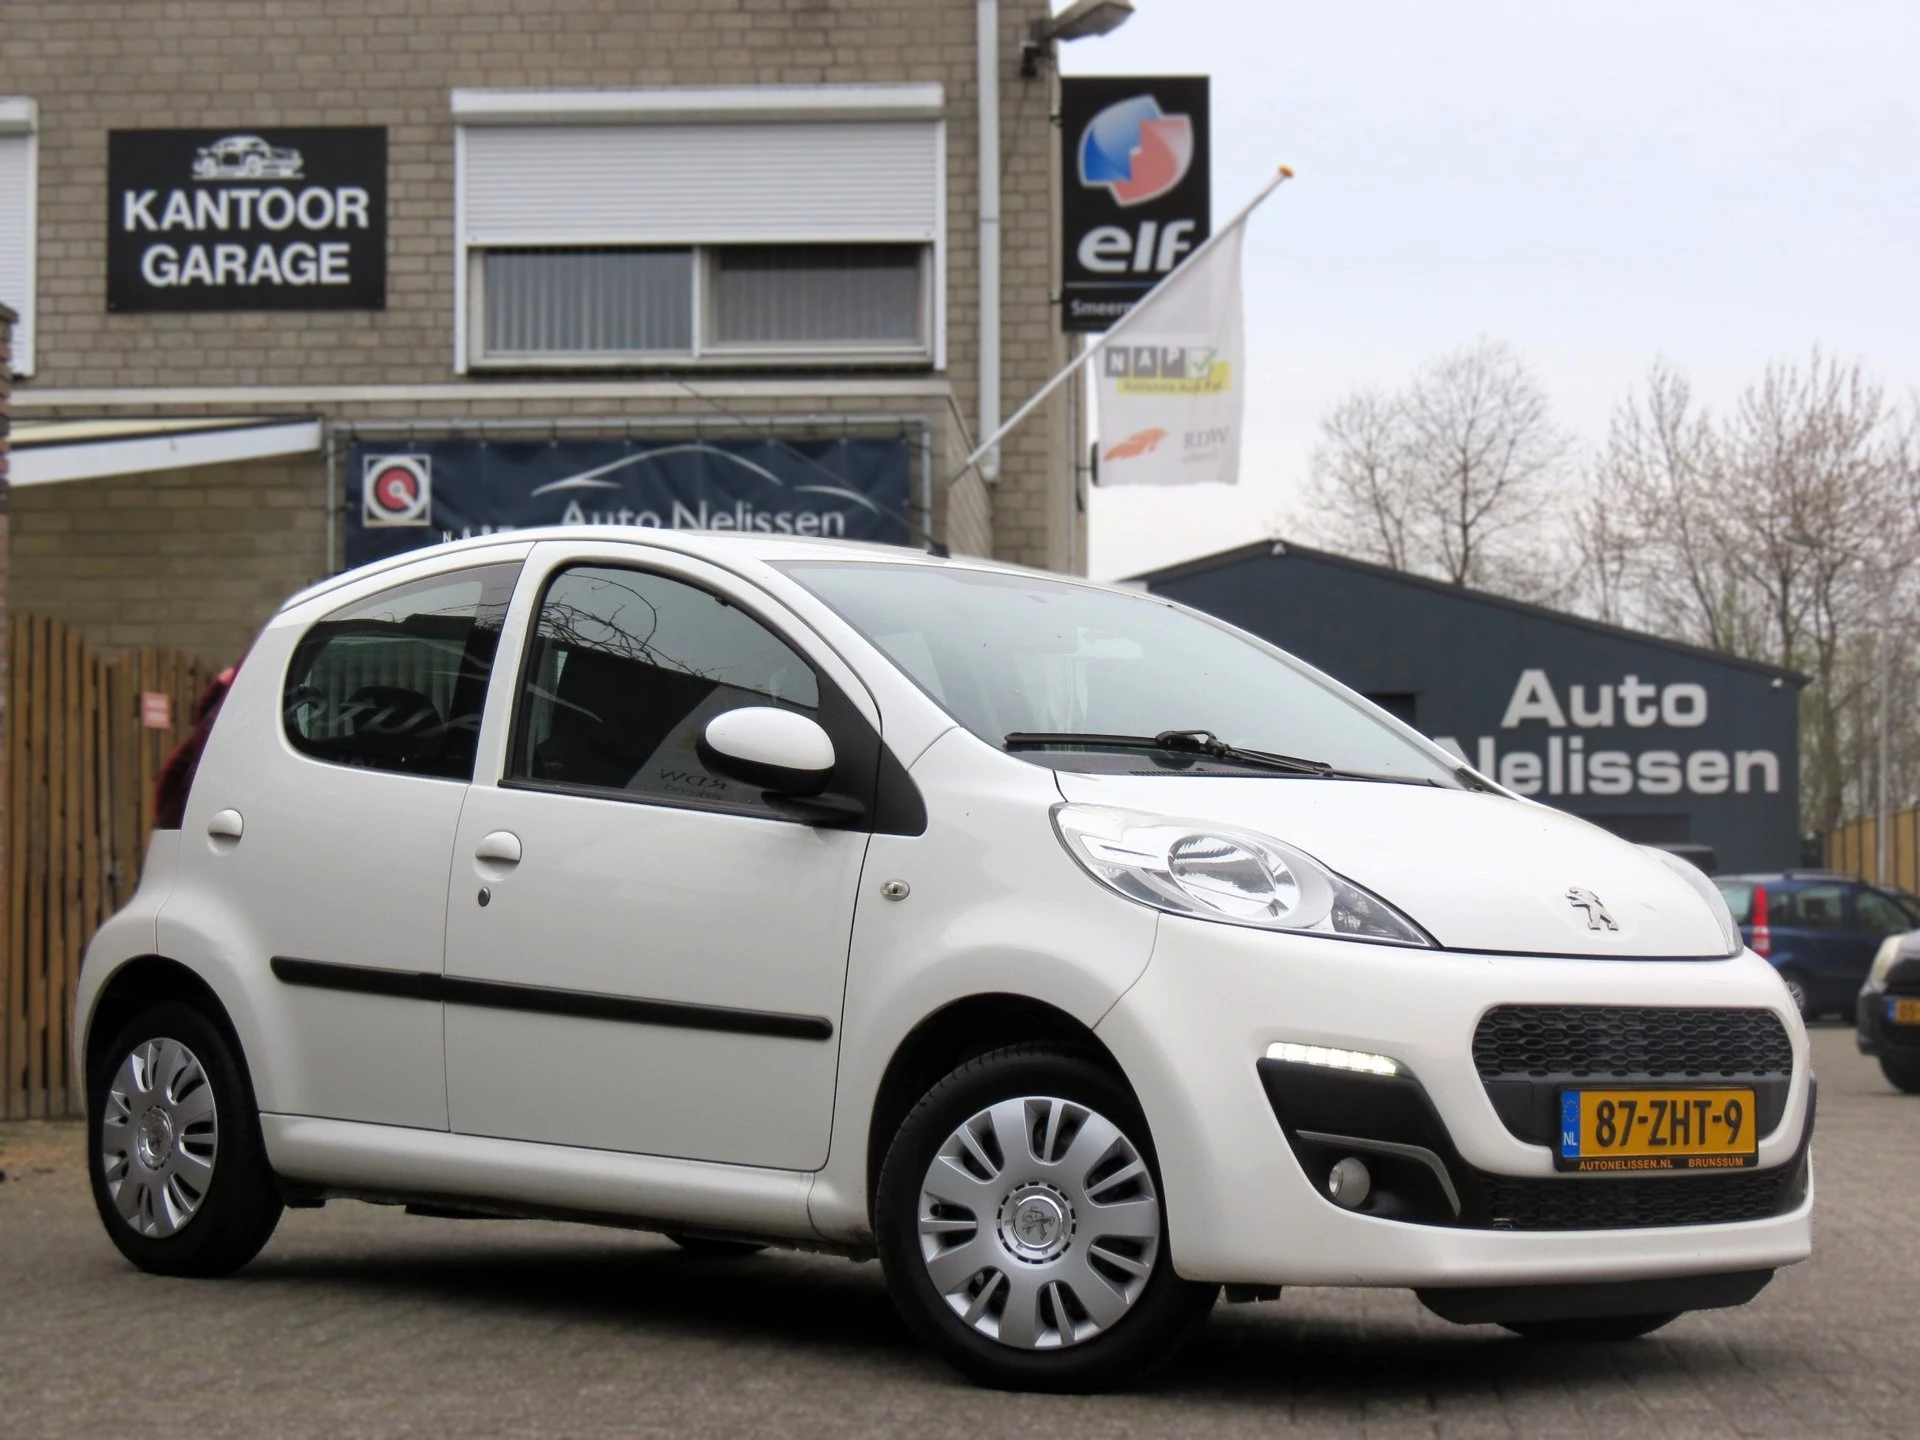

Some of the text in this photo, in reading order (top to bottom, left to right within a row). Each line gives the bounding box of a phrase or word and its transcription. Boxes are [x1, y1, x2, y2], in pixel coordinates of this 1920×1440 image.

[124, 187, 369, 231] KANTOOR
[141, 243, 350, 287] GARAGE
[1077, 220, 1196, 273] elf
[562, 500, 845, 536] Auto Nelissen
[1501, 668, 1708, 727] Auto
[1433, 735, 1780, 795] Nelissen
[1563, 1131, 1578, 1146] NL
[1595, 1099, 1743, 1147] 87-ZHT-9
[1578, 1157, 1744, 1171] AUTONELISSEN.NL BRUNSSUM
